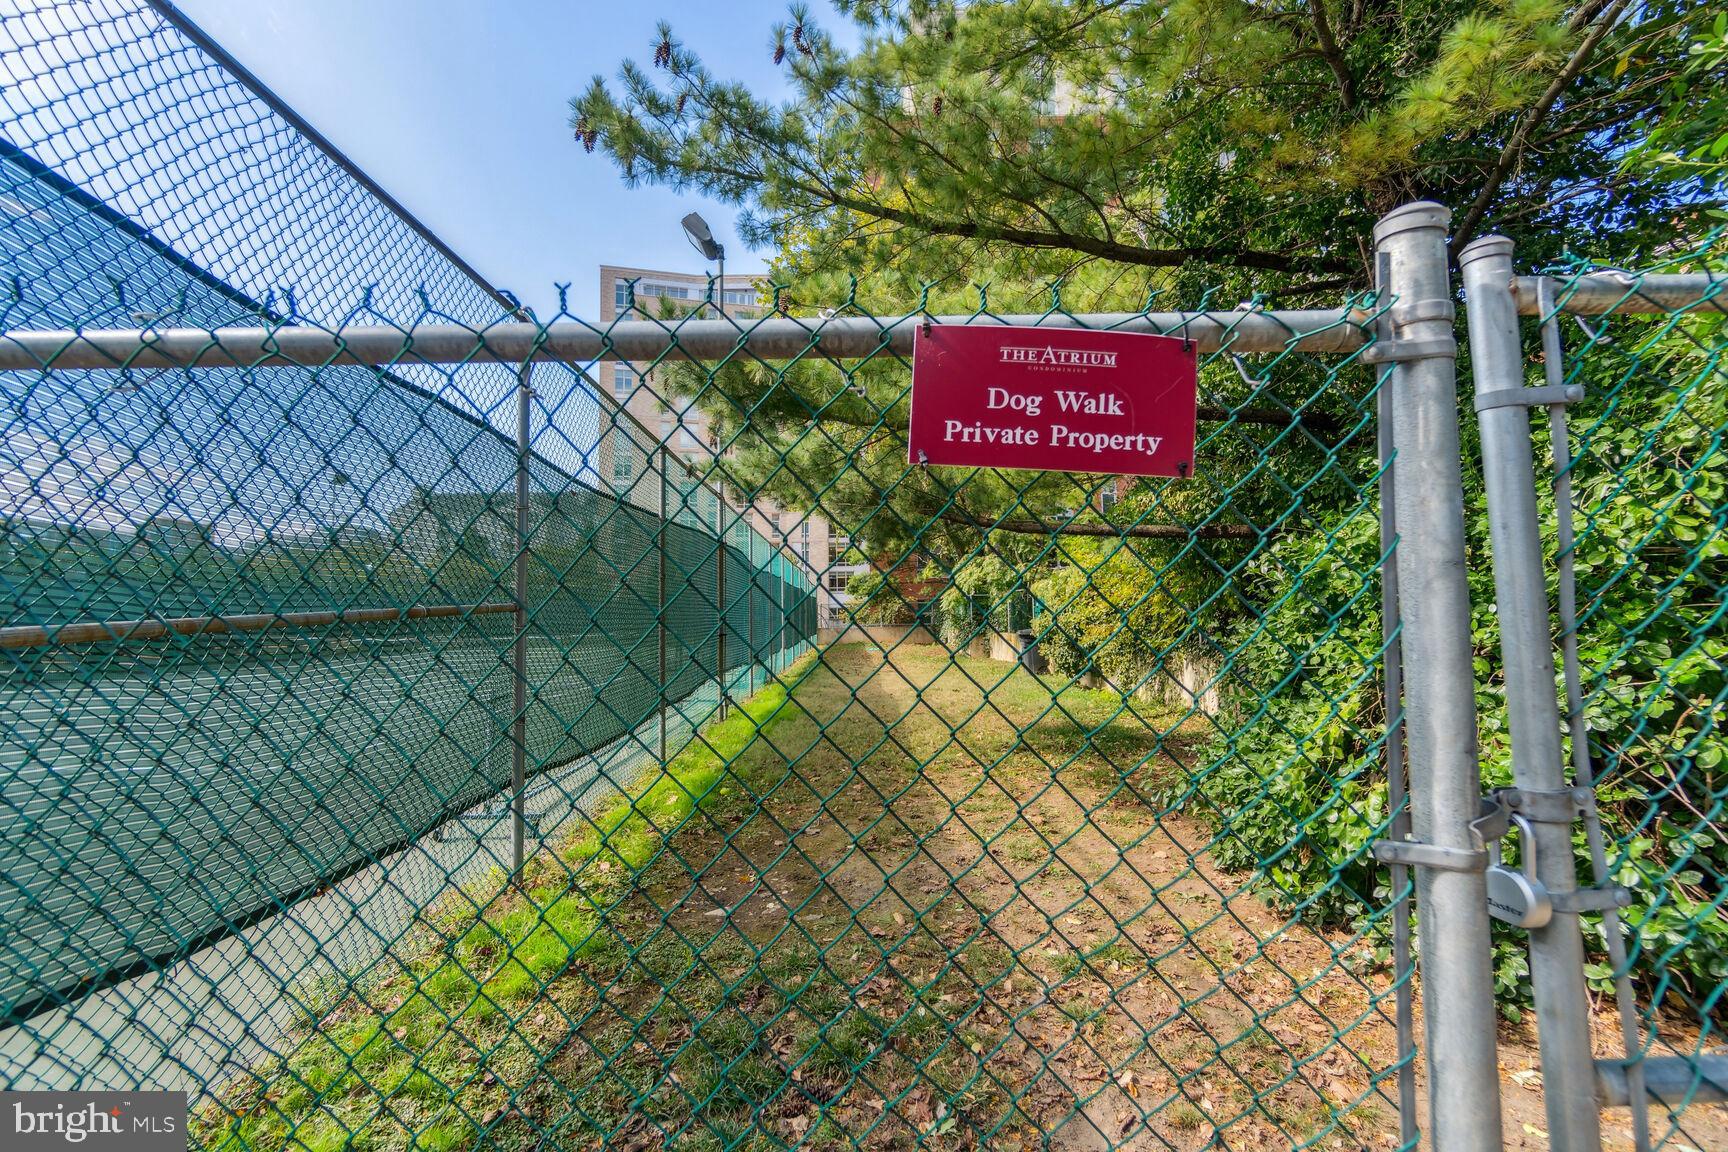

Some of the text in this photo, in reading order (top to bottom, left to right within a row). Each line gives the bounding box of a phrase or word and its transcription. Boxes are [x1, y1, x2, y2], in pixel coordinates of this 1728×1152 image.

[1000, 345, 1116, 366] THE ATRIUM
[1027, 365, 1088, 373] CONDOMINIUM
[987, 387, 1124, 416] Dog Walk
[944, 420, 1163, 455] Private Property
